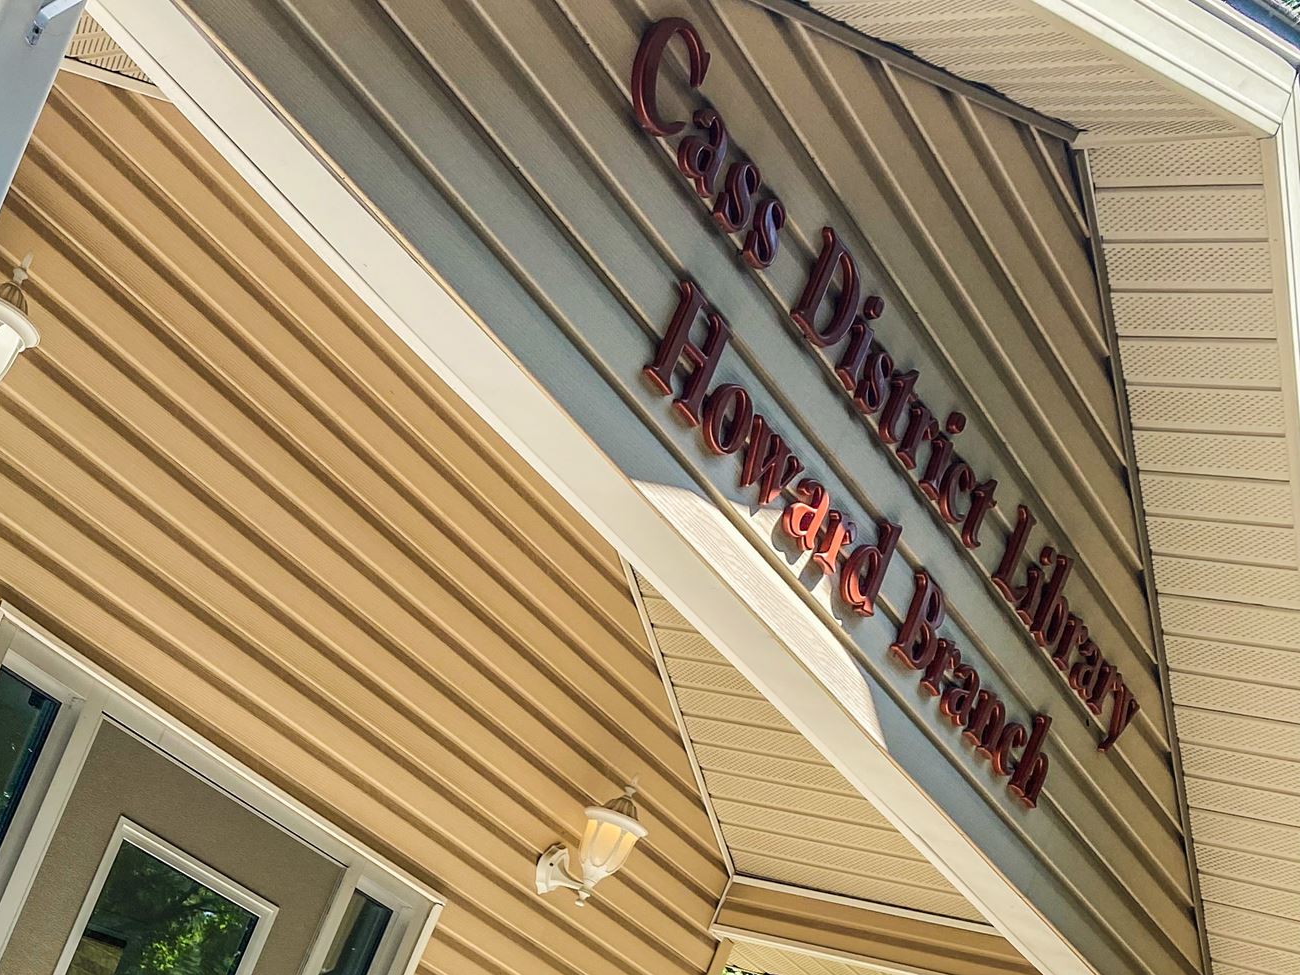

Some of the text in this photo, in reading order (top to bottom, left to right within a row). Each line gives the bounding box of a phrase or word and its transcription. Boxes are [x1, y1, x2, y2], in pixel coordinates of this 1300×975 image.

[631, 17, 1140, 753] Cass District Library
[642, 280, 1053, 808] Howard Branch
